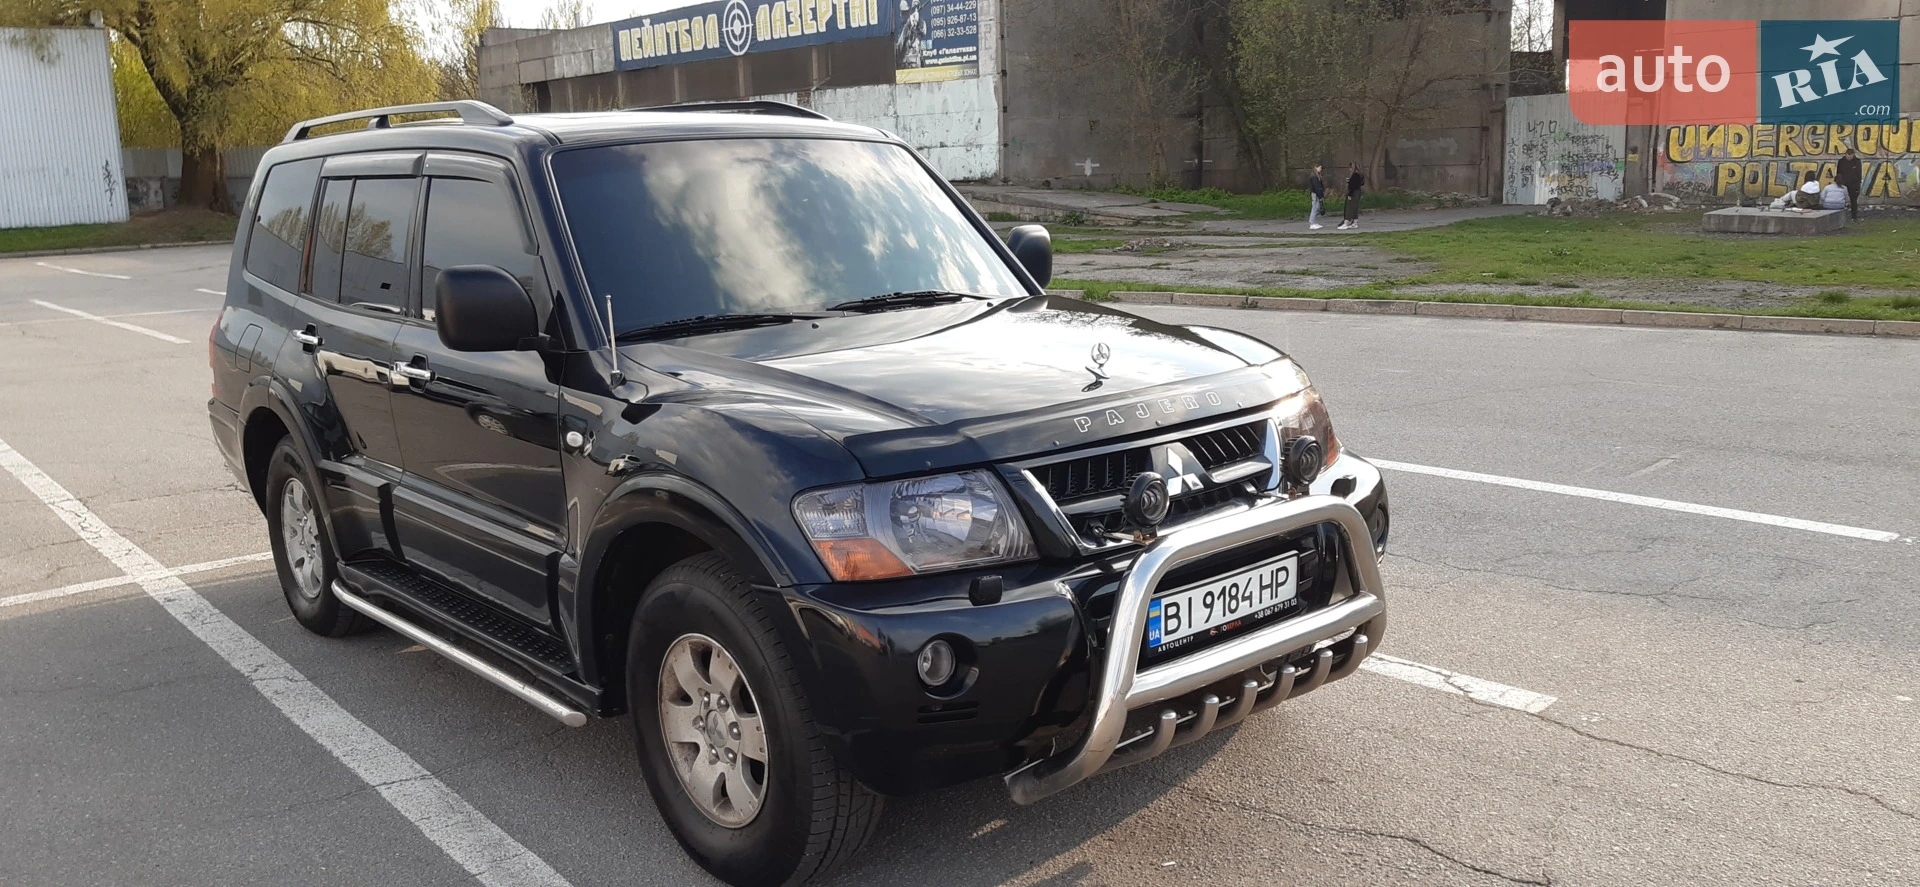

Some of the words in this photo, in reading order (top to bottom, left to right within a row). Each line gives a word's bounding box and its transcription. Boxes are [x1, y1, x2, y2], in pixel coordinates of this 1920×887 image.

[931, 5, 946, 16] (097)
[947, 1, 977, 12] 34-44-229
[931, 17, 946, 28] (095)
[947, 13, 977, 25] 926-87-13
[619, 14, 720, 61] ПЕЙНТБОЛ
[932, 29, 947, 40] (066)
[947, 25, 977, 37] 32-33-528
[1074, 392, 1222, 433] PAJERO
[1164, 597, 1192, 637] BI
[1202, 577, 1253, 624] 9184
[1259, 566, 1289, 605] HP
[1254, 609, 1264, 619] +38
[1264, 606, 1274, 616] 067
[1274, 603, 1284, 613] 679
[1284, 601, 1290, 609] 31
[1150, 629, 1160, 640] UA
[1157, 636, 1194, 653] АВТОЦЕНТР
